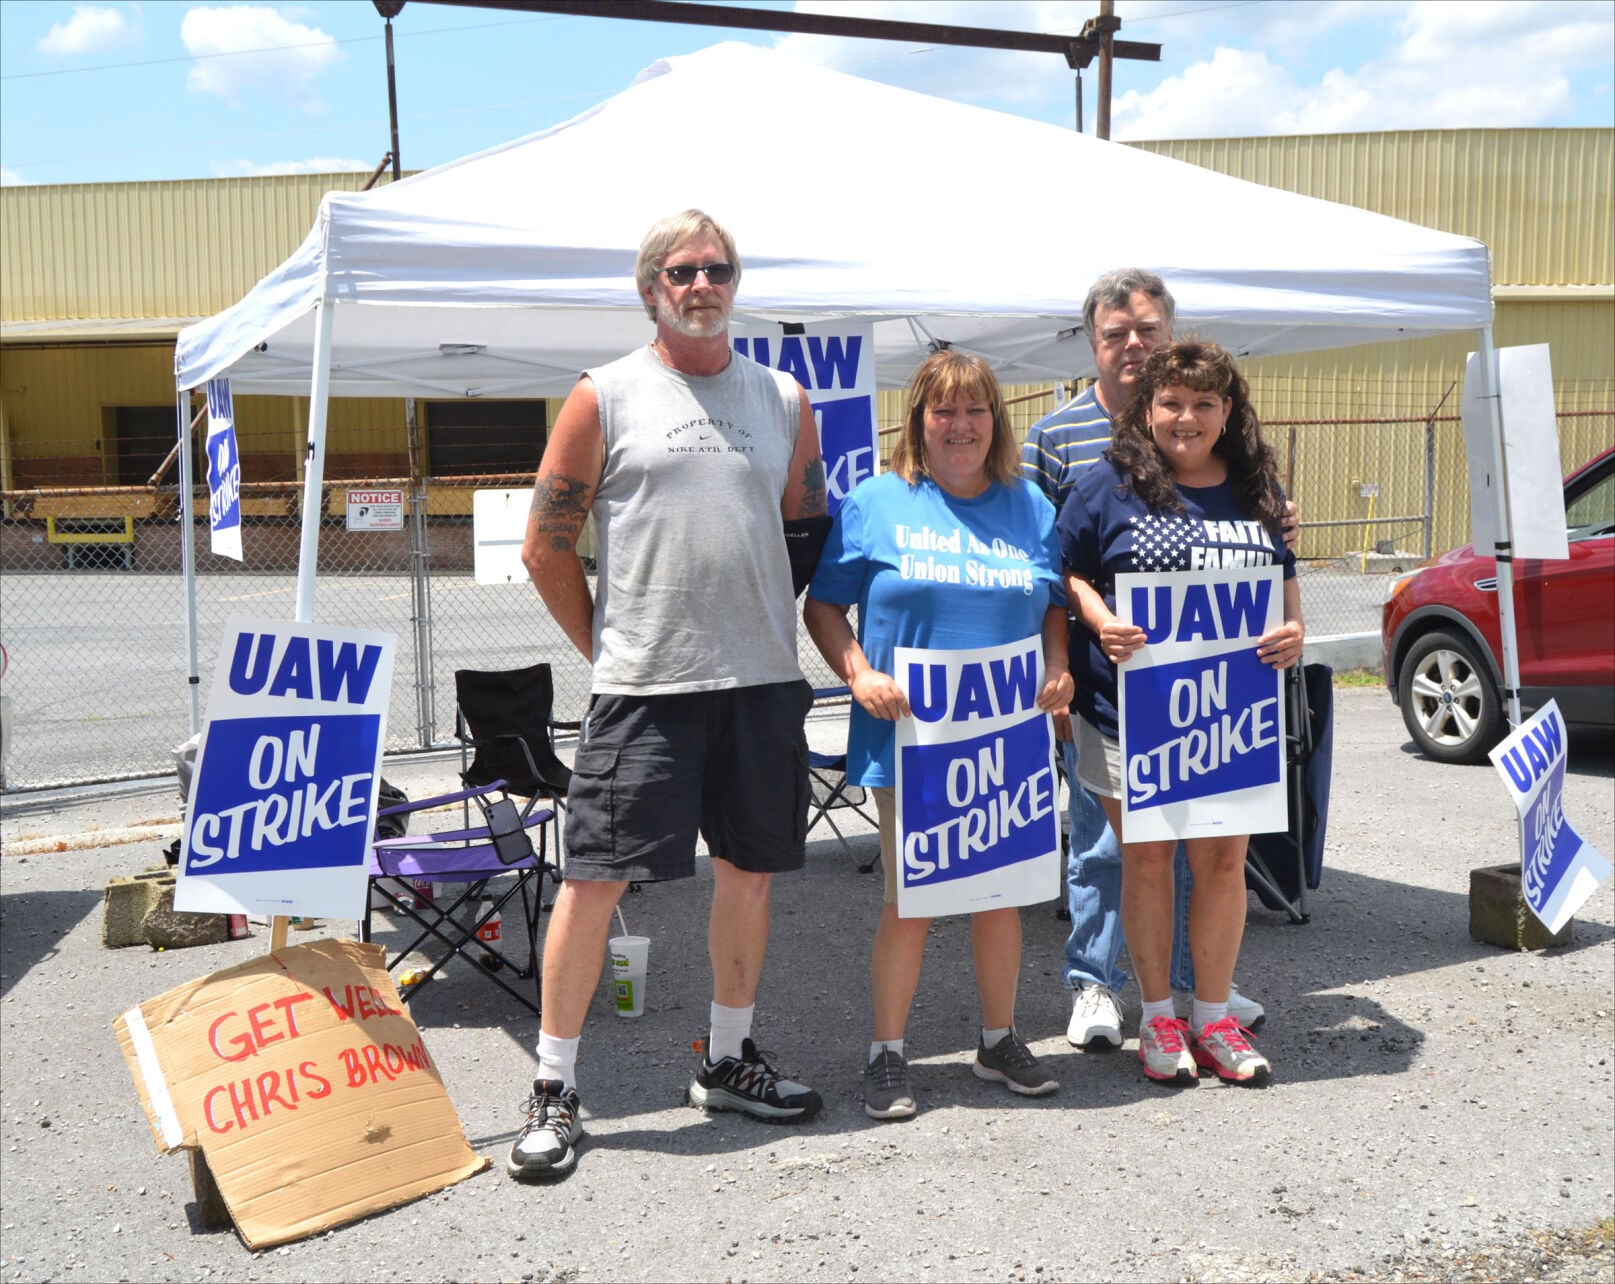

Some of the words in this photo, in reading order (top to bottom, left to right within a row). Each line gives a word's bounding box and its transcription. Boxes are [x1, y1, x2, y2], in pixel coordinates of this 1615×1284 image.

[218, 438, 230, 479] ON
[666, 418, 734, 439] PROPERTY
[738, 429, 752, 439] OF
[212, 464, 239, 527] STRIKE
[351, 493, 399, 503] NOTICE
[895, 524, 961, 554] United
[967, 533, 990, 556] As
[992, 537, 1029, 562] One
[900, 554, 960, 584] Union
[965, 560, 1034, 596] Strong
[1131, 579, 1272, 645] UAW
[229, 632, 383, 705] UAW
[908, 650, 1036, 723] UAW
[1169, 661, 1227, 728] ON
[249, 724, 321, 790] ON
[946, 737, 1004, 807] ON
[1128, 697, 1277, 804] STRIKE
[1501, 711, 1561, 793] UAW
[190, 773, 372, 868] STRIKE
[904, 767, 1052, 881] STRIKE
[1534, 781, 1551, 841] ON
[1524, 790, 1564, 907] STRIKE
[208, 992, 314, 1062] GET
[323, 985, 402, 1020] WELL
[203, 1061, 331, 1134] CHRIS
[338, 1037, 431, 1088] BROWN
